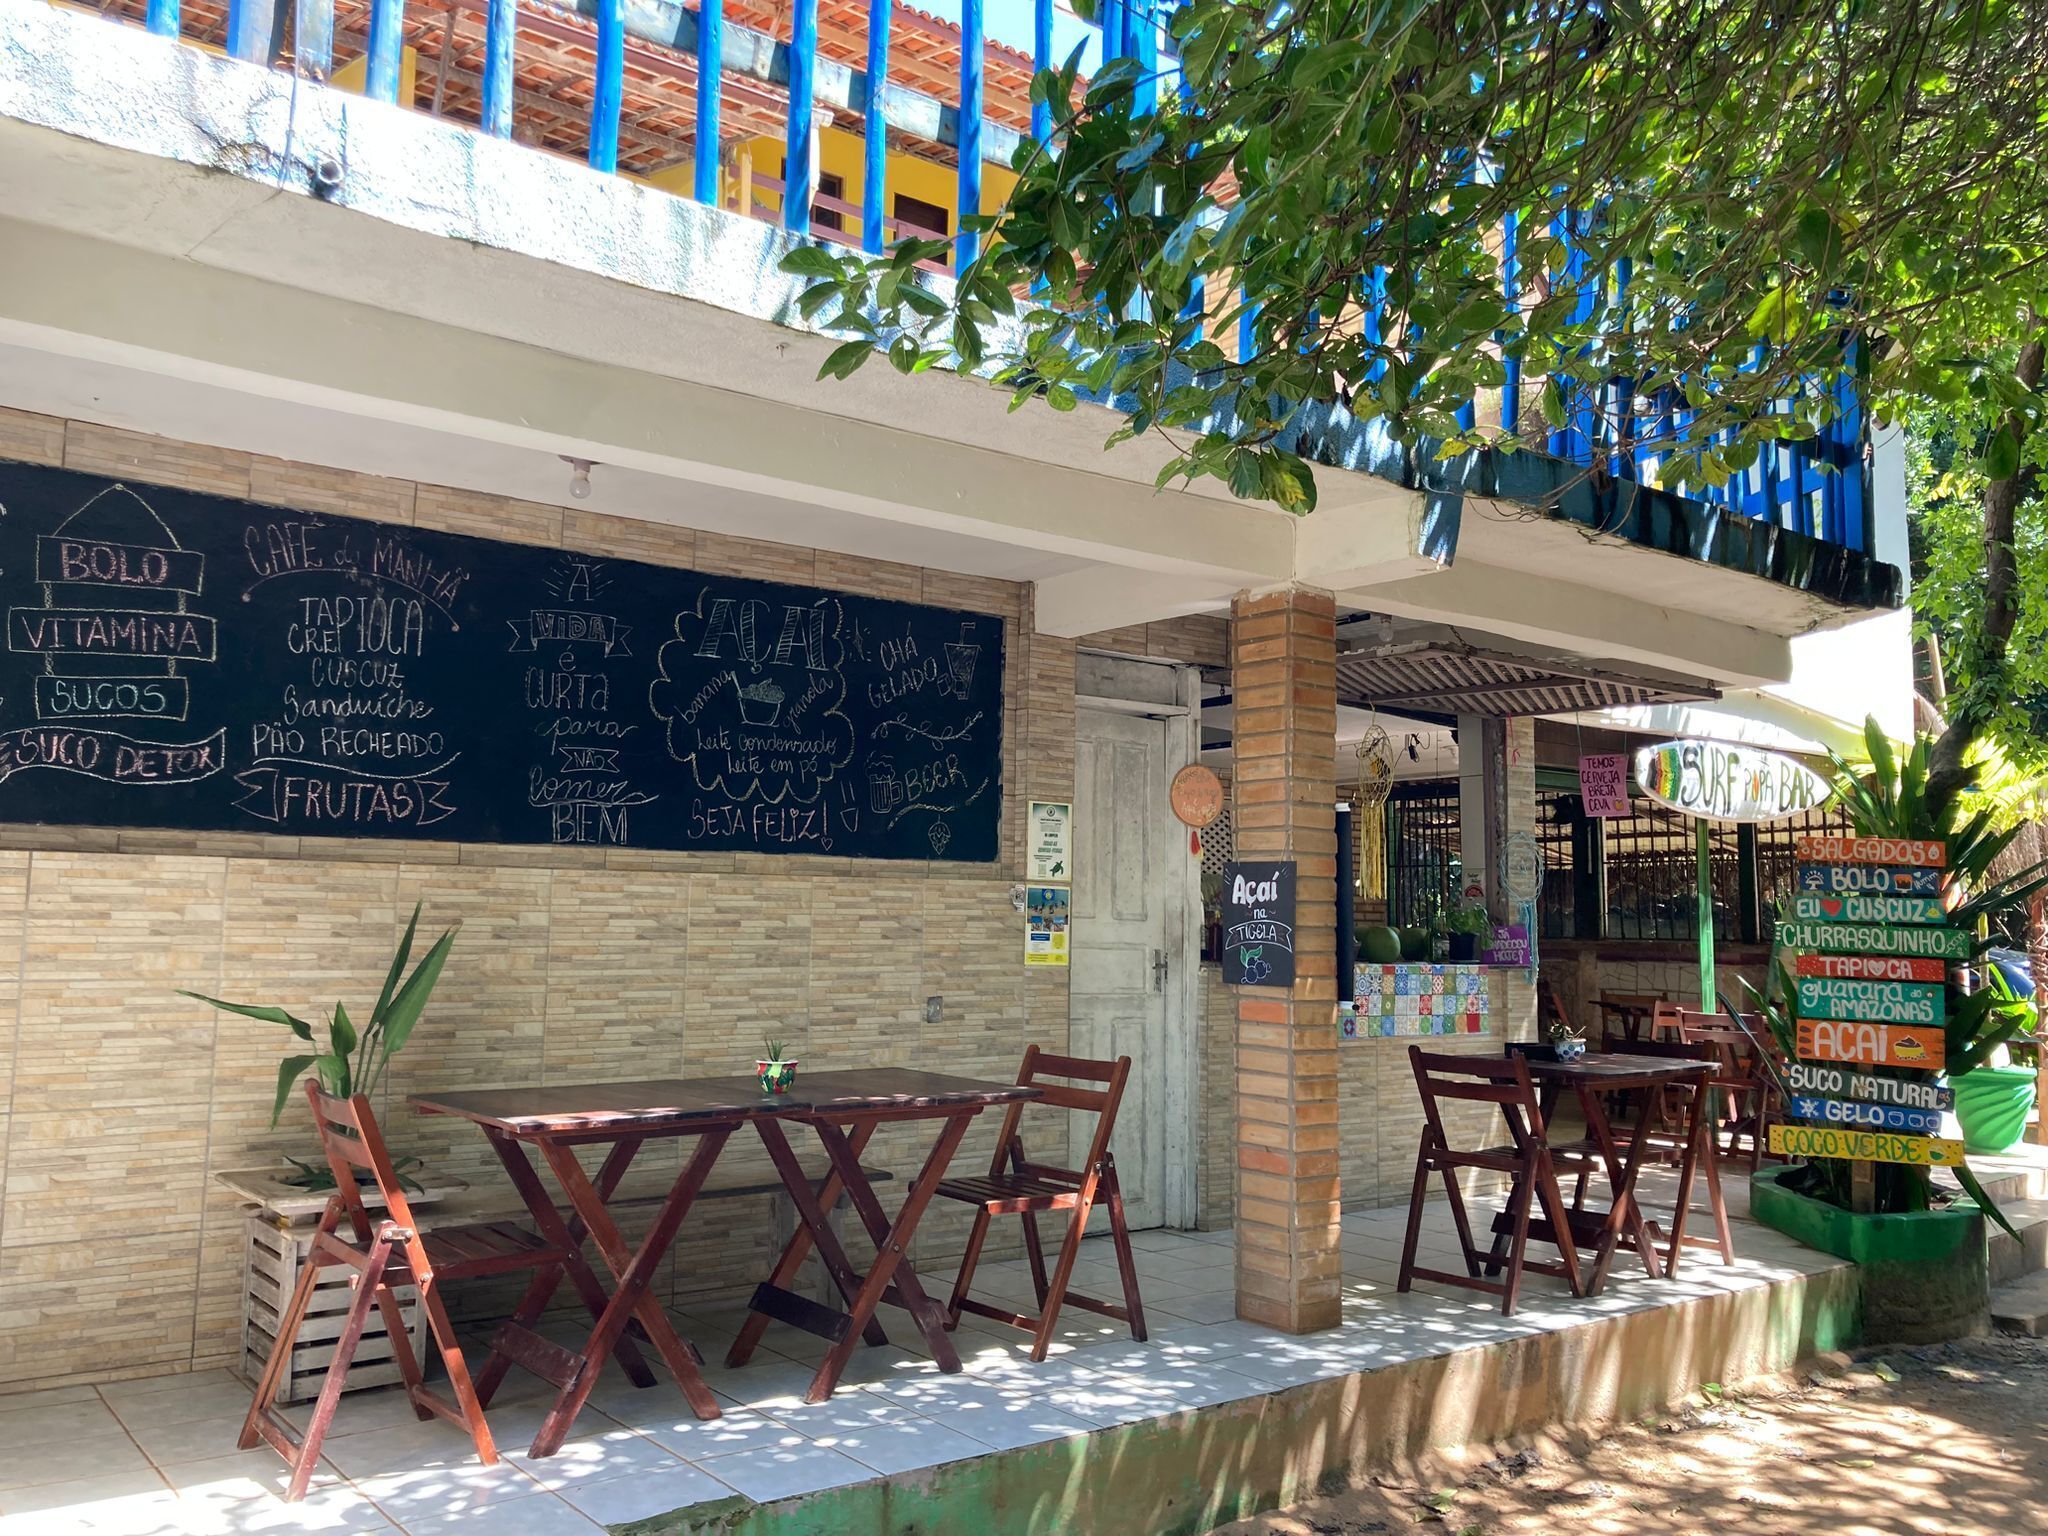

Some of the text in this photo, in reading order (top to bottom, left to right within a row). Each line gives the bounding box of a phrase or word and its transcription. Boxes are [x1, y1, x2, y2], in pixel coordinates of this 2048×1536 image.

[60, 542, 169, 584] BOLO
[245, 517, 325, 577] CAFÉ
[373, 537, 470, 608] MANHÃ
[567, 563, 594, 601] A
[298, 596, 423, 656] TAPIOCA
[692, 598, 829, 674] AÇAÍ
[558, 645, 577, 672] é
[880, 621, 919, 672] CHÁ
[311, 656, 405, 688] CUSCUZ
[868, 656, 938, 708] GELADO
[51, 680, 167, 714] SUCOS
[284, 684, 434, 725] Sanduíche
[674, 670, 732, 724] banana
[783, 672, 834, 735] granola
[15, 729, 217, 778] SUCO DETOX
[252, 722, 444, 759] PÃO RECHEADO
[535, 716, 639, 755] para
[770, 758, 794, 774] em
[799, 755, 818, 784] pó
[904, 754, 968, 801] BEER
[1581, 770, 1620, 785] CERVEJA
[1585, 757, 1615, 769] TEMOS
[1681, 744, 1740, 817] SURF
[1779, 760, 1816, 813] BAR
[282, 776, 415, 822] FRUTAS
[1588, 785, 1617, 797] BREJA
[552, 802, 628, 845] BEM
[687, 798, 746, 838] SEJA
[1811, 839, 1926, 865] SALGADOS
[1231, 870, 1280, 908] Açaí
[1831, 867, 1890, 891] BOLO
[1253, 908, 1267, 919] na
[1796, 898, 1926, 921] EU CUSCUZ
[1802, 980, 1904, 1008] guaraná
[1831, 998, 1934, 1022] AMAZONAS
[1789, 1064, 1947, 1109] SUCO NATURAL
[1825, 1100, 1885, 1125] GELO
[1782, 1128, 1922, 1162] COCO VERDE
